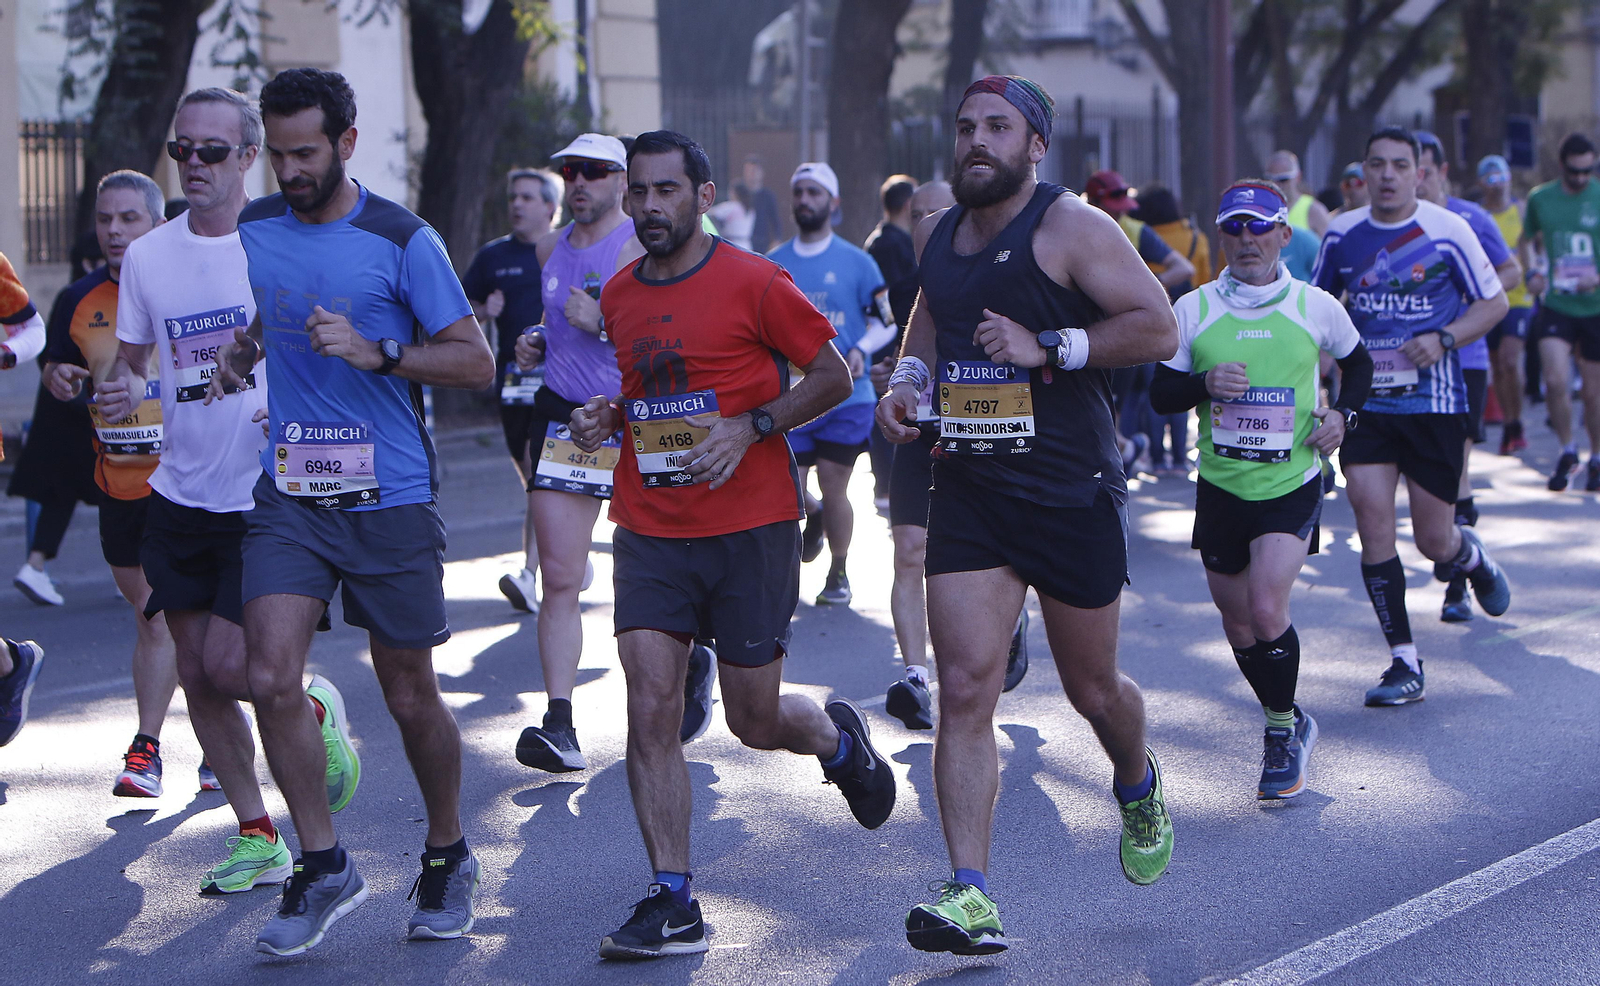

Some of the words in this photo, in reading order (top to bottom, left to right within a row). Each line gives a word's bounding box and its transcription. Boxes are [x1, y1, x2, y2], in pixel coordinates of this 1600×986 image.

[184, 312, 236, 333] ZURICH
[1235, 329, 1272, 341] joma
[631, 338, 684, 354] SEVILLA
[1366, 337, 1404, 349] ZURICH
[190, 345, 221, 363] 765
[1374, 360, 1395, 371] 075
[632, 350, 689, 397] 10
[962, 367, 1016, 380] ZURICH
[651, 397, 705, 415] ZURICH
[963, 400, 999, 415] 4797
[1236, 417, 1270, 431] 7786
[101, 429, 159, 441] QUEMASUELAS
[304, 427, 361, 440] ZURICH
[658, 432, 694, 448] 4168
[1236, 435, 1266, 446] JOSEP
[304, 460, 343, 474] 6942
[567, 453, 598, 467] 4374
[569, 469, 586, 479] AFA
[308, 481, 342, 493] MARC
